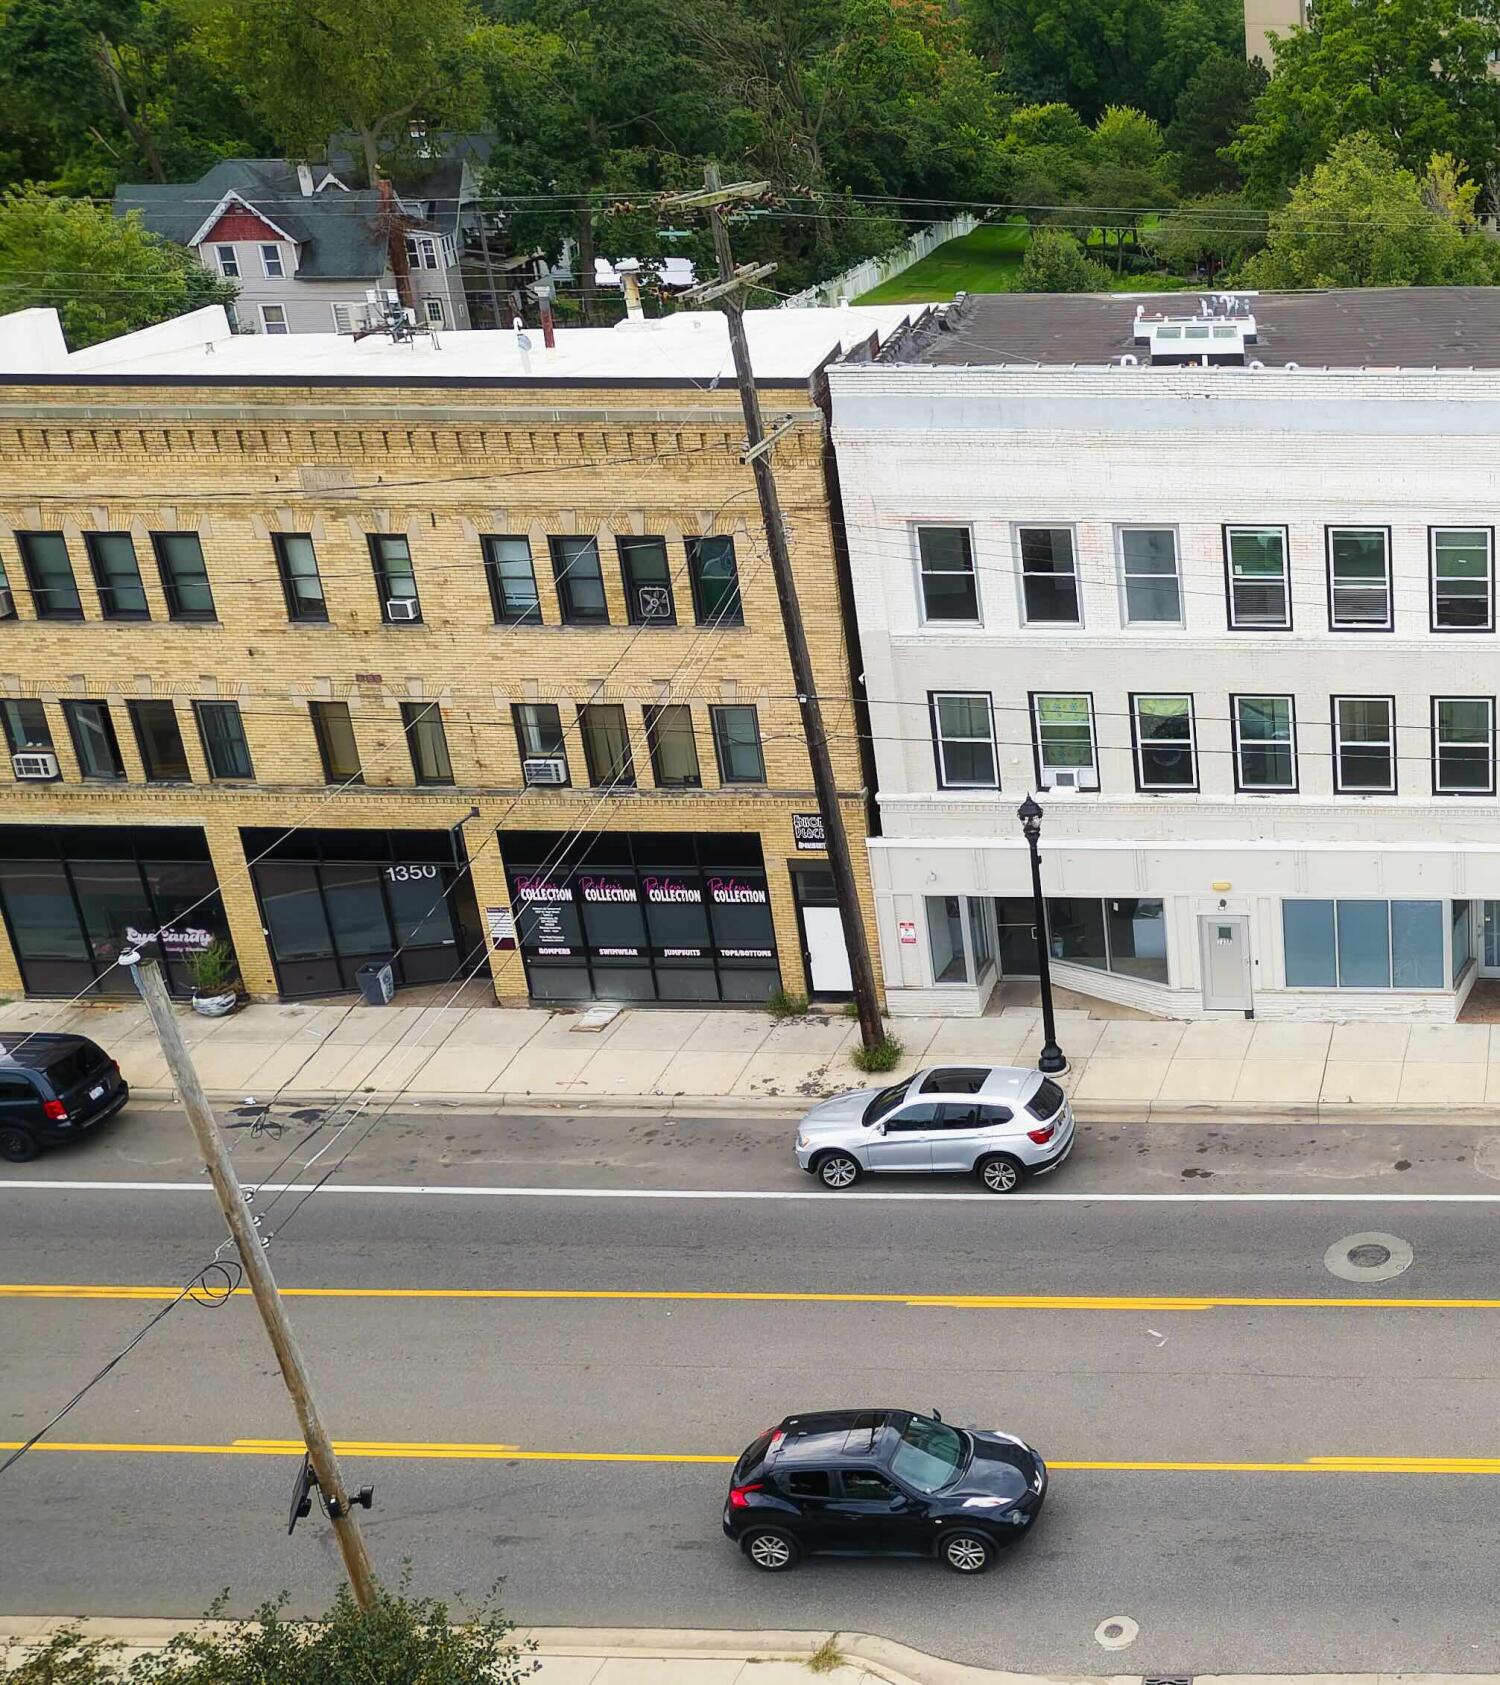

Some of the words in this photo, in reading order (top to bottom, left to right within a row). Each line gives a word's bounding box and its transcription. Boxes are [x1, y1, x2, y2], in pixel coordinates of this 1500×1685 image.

[385, 865, 437, 881] 1350
[520, 888, 573, 901] COLLECTION
[584, 888, 637, 902] COLLECTION
[649, 889, 702, 903] COLLECTION
[713, 890, 766, 903] COLLECTION
[664, 949, 701, 957] JUMPSUITS
